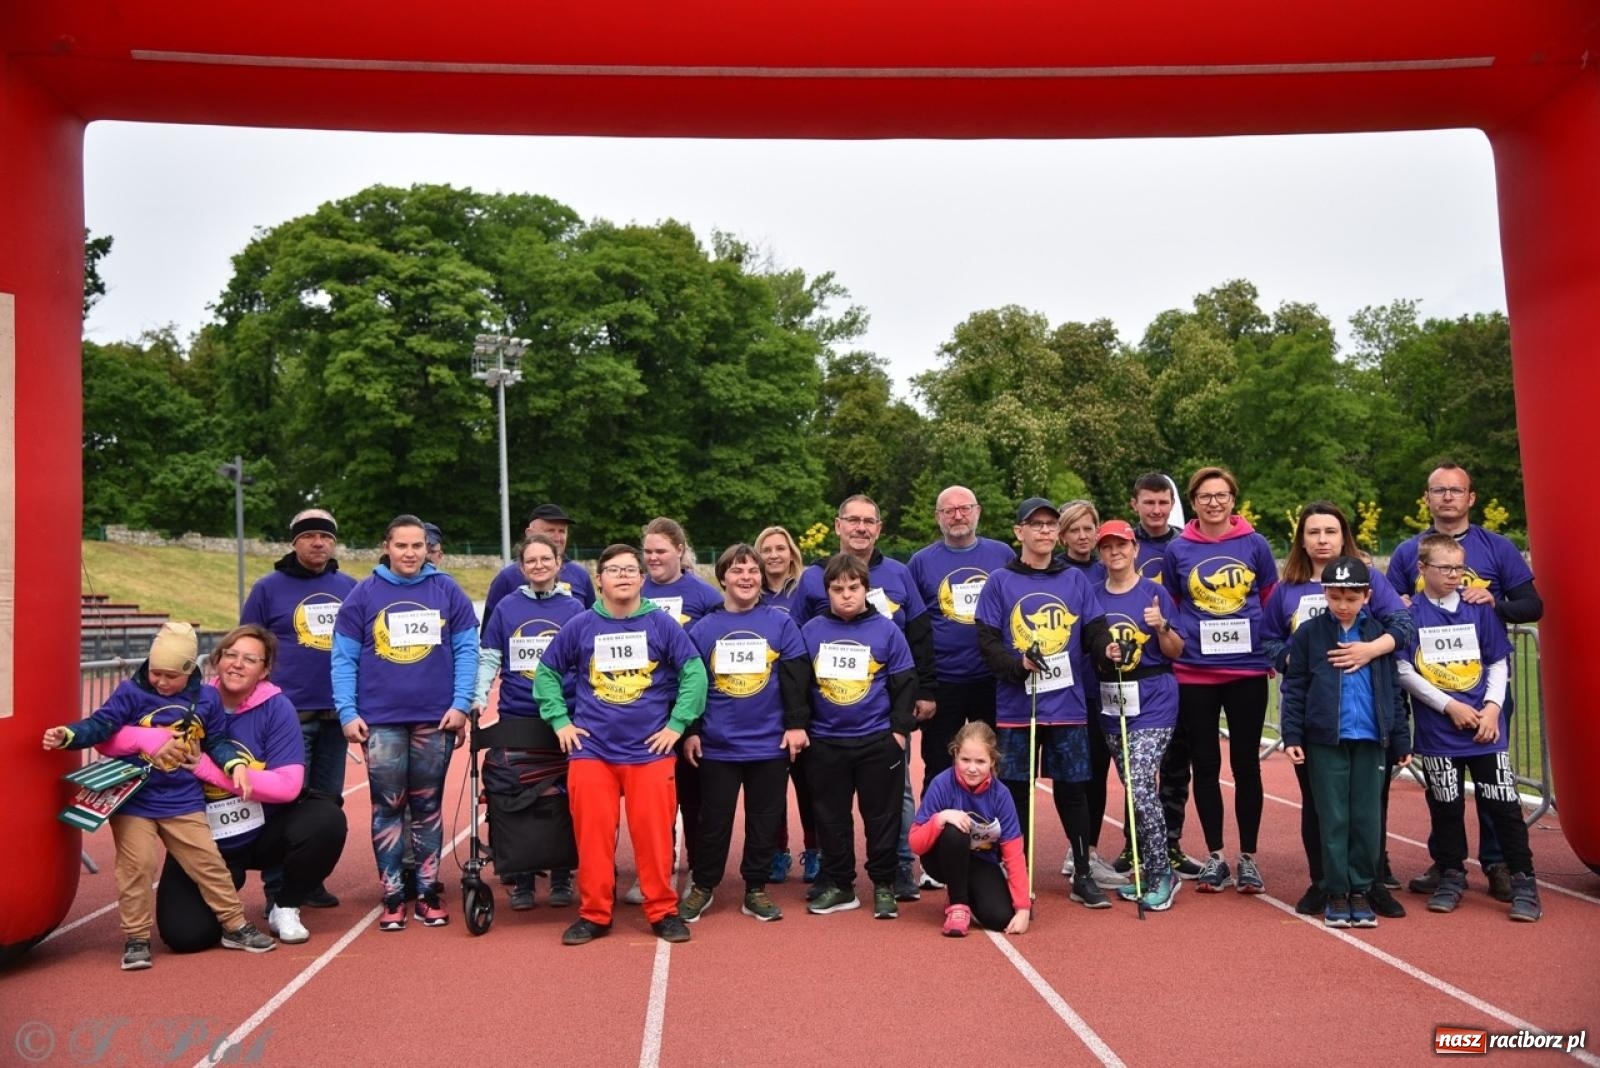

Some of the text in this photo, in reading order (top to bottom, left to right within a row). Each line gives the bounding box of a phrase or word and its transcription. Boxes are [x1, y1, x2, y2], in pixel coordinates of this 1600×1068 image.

[964, 593, 980, 605] 07
[317, 613, 337, 625] 03
[404, 622, 429, 635] 126
[1211, 630, 1240, 643] 054
[1434, 637, 1464, 650] 014
[518, 648, 544, 660] 098
[610, 645, 633, 659] 118
[729, 650, 754, 663] 154
[832, 656, 856, 669] 158
[1038, 665, 1062, 681] 150
[219, 807, 251, 825] 030
